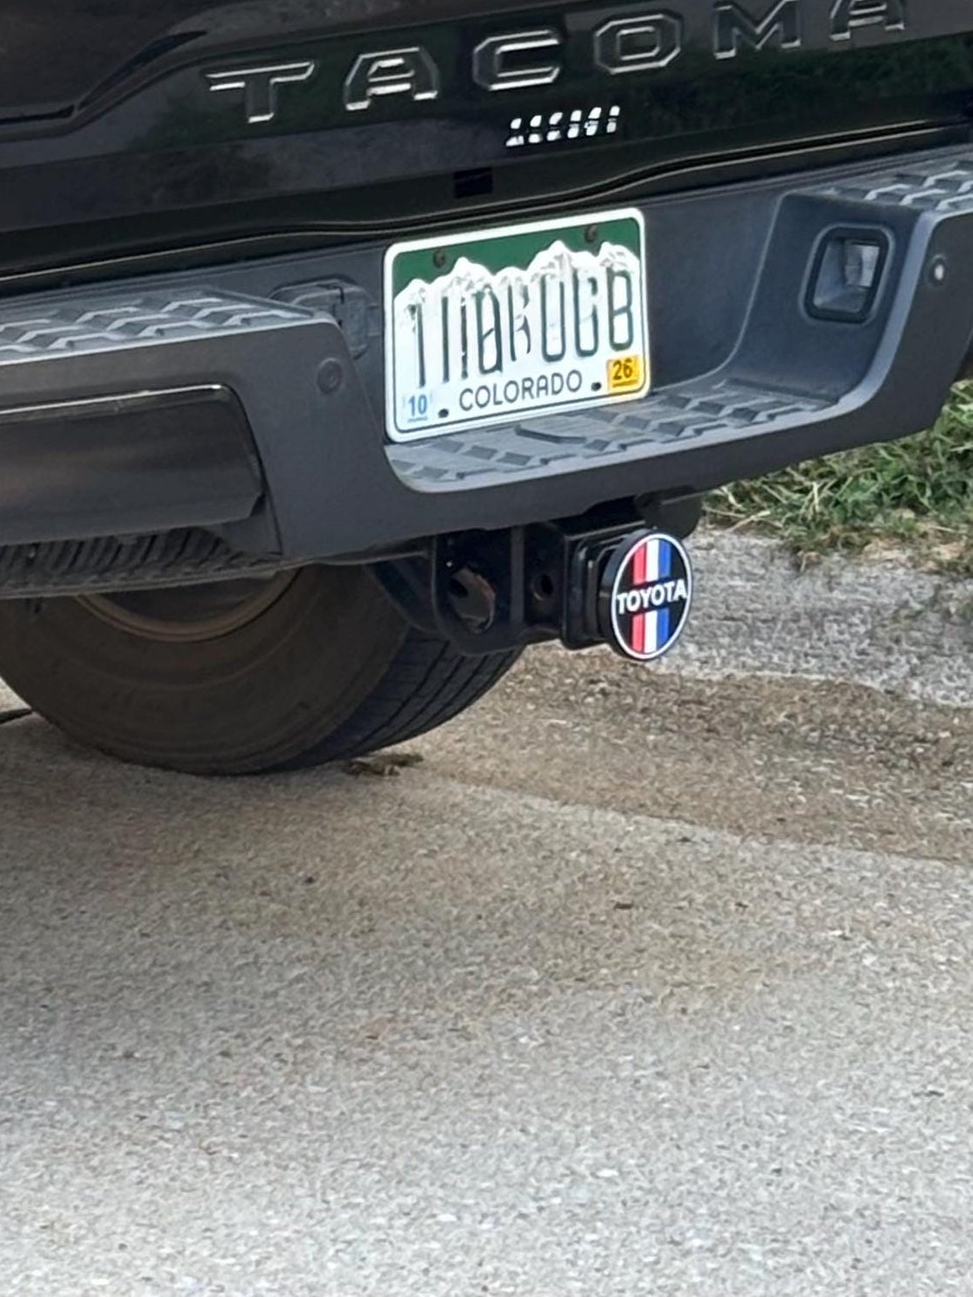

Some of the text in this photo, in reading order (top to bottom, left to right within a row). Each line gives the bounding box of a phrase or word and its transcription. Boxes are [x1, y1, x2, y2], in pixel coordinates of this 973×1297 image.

[612, 358, 633, 381] 26
[459, 369, 583, 411] COLORADO
[408, 394, 428, 417] 10
[616, 579, 687, 615] TOYOTA
